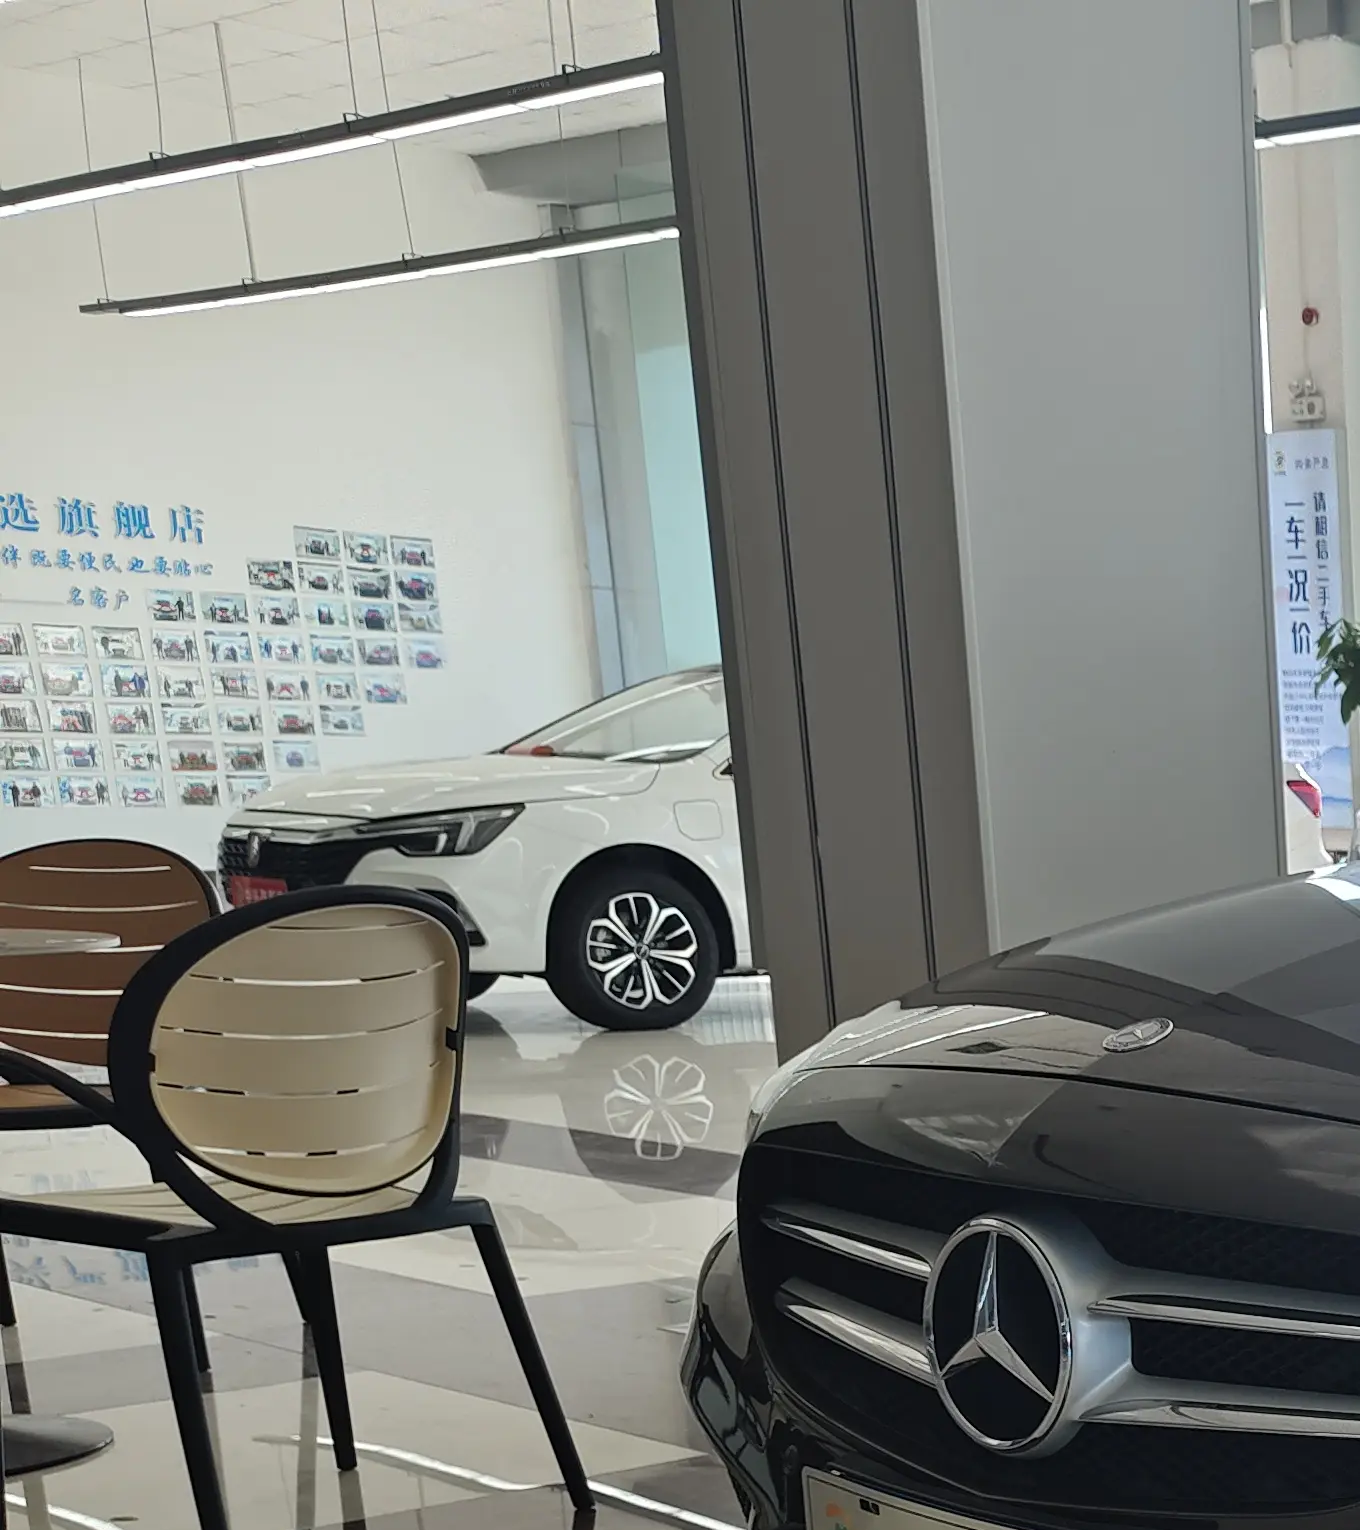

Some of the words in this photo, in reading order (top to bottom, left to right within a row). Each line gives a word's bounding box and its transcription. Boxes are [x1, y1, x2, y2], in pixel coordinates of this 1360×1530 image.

[0, 492, 205, 545] 选旗舰店
[1284, 501, 1311, 655] 一车一况一价
